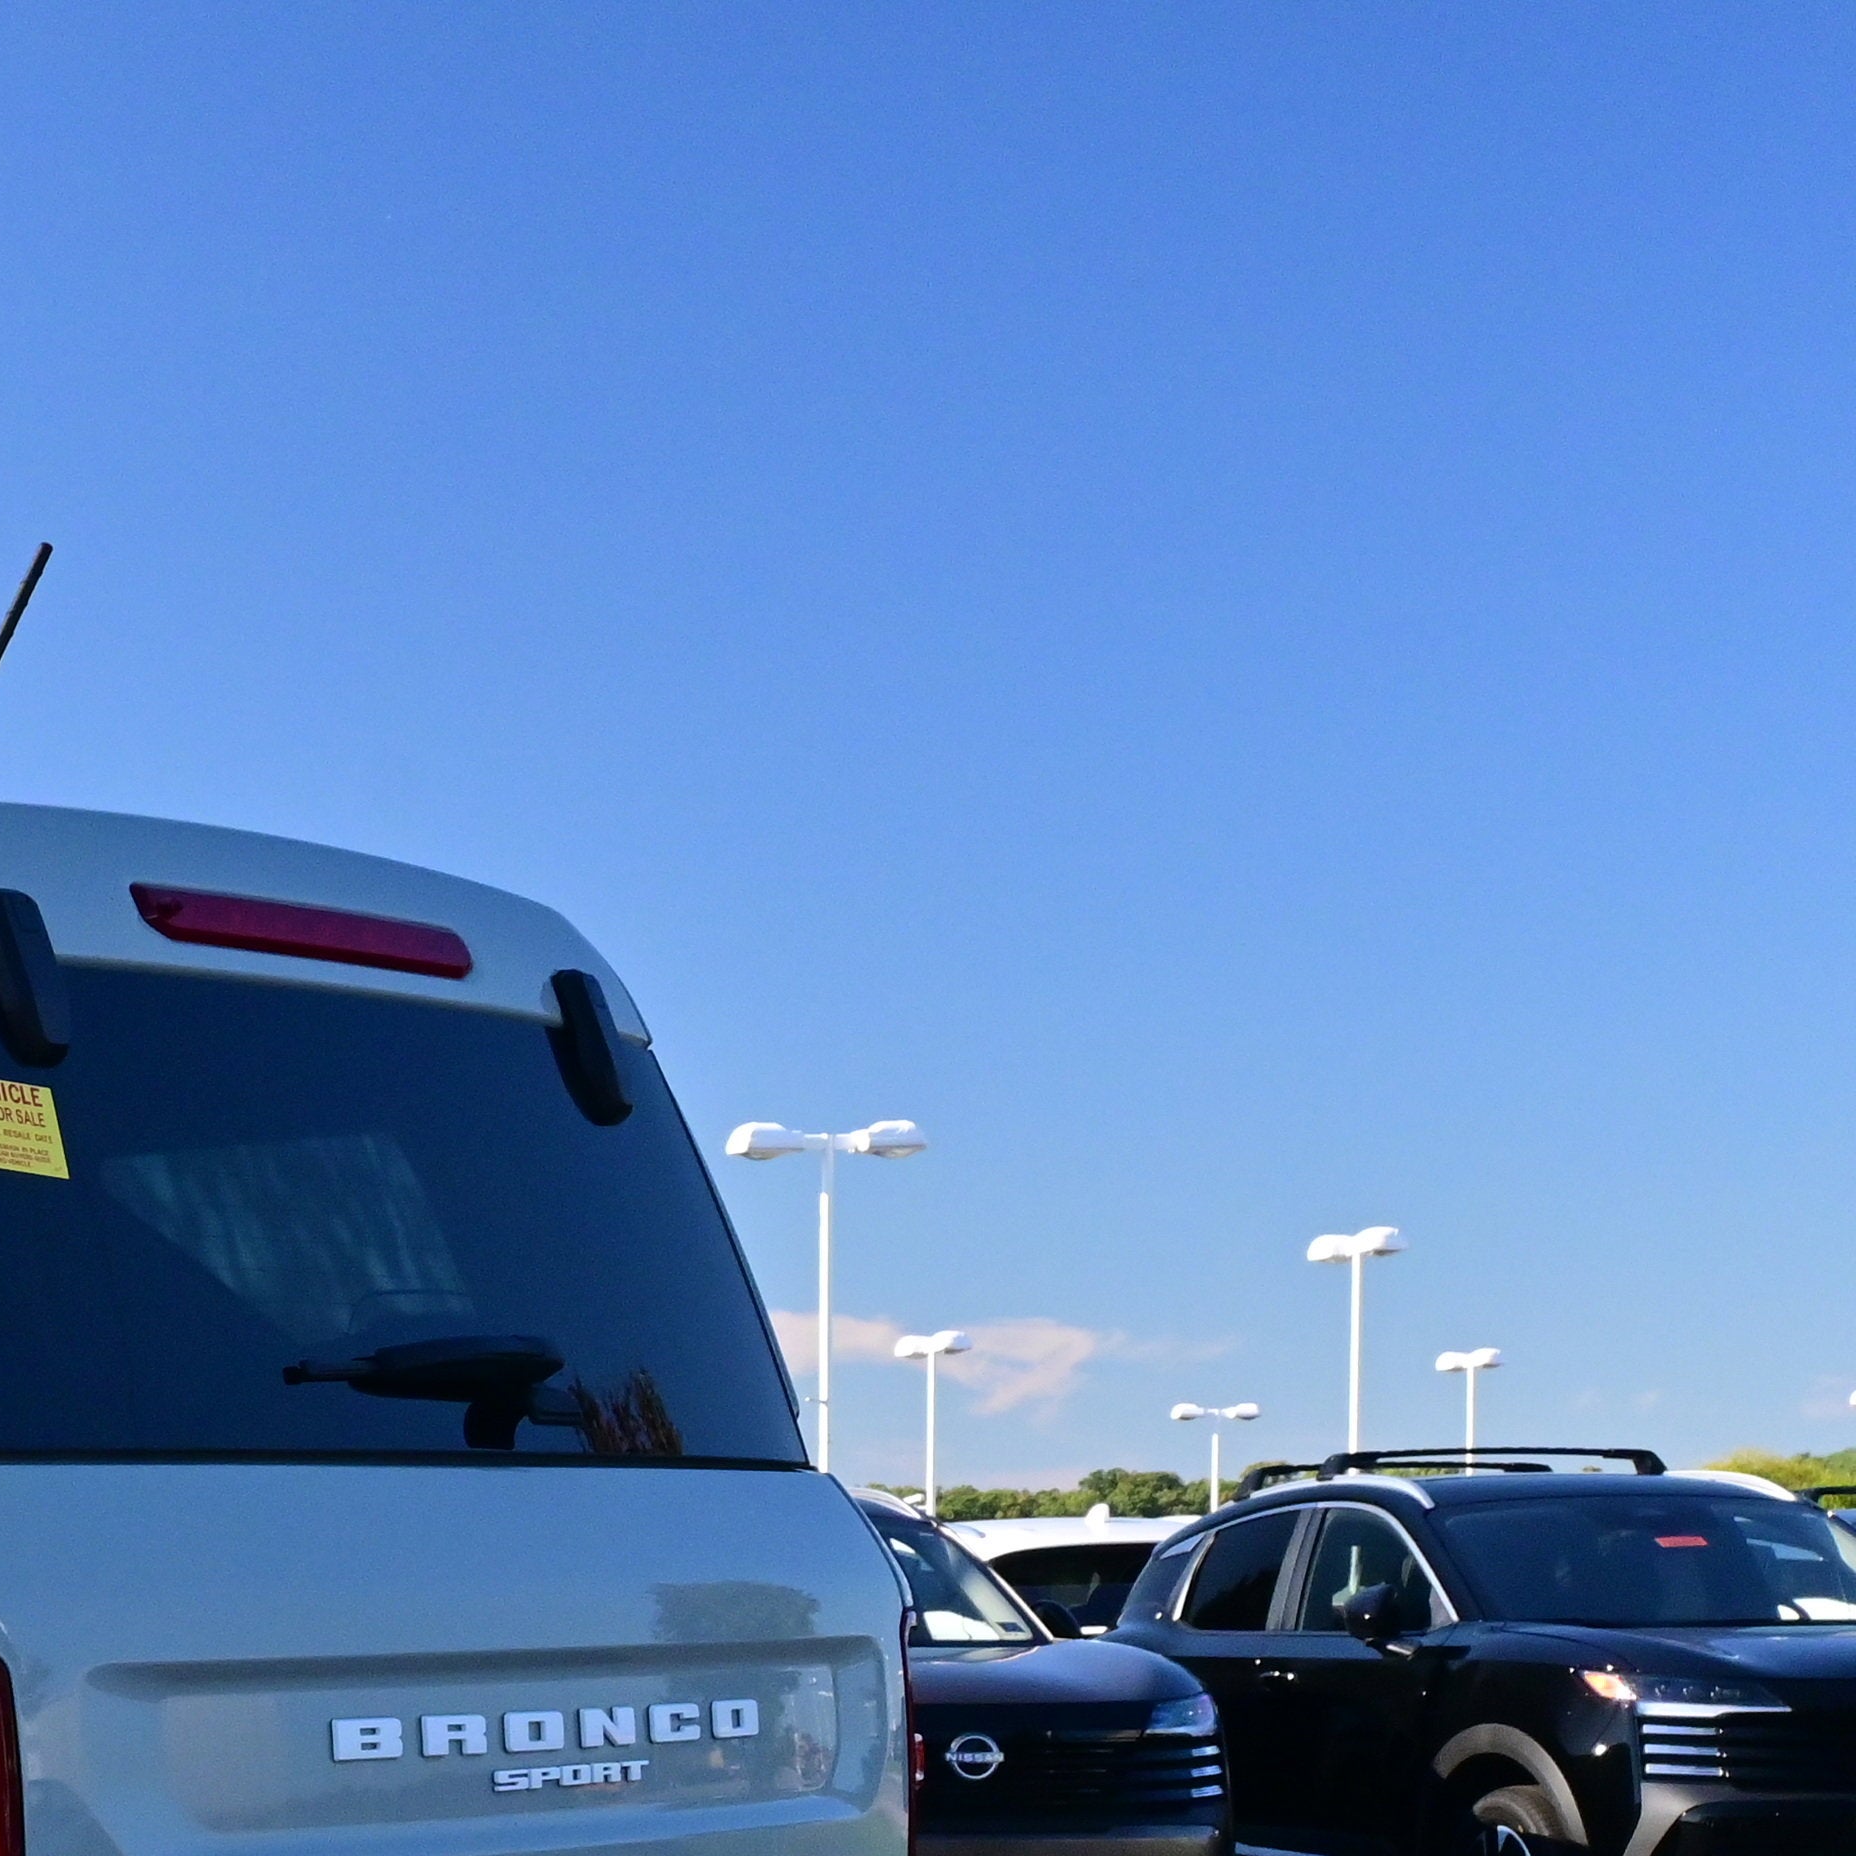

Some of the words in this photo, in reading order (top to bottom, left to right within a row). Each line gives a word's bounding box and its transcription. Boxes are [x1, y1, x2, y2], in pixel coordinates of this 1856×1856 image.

[15, 1109, 46, 1128] SALE
[3, 1128, 31, 1140] RESALE
[330, 1698, 760, 1763] BRONCO
[945, 1752, 1004, 1763] NISSAN
[493, 1760, 650, 1793] SPORT
